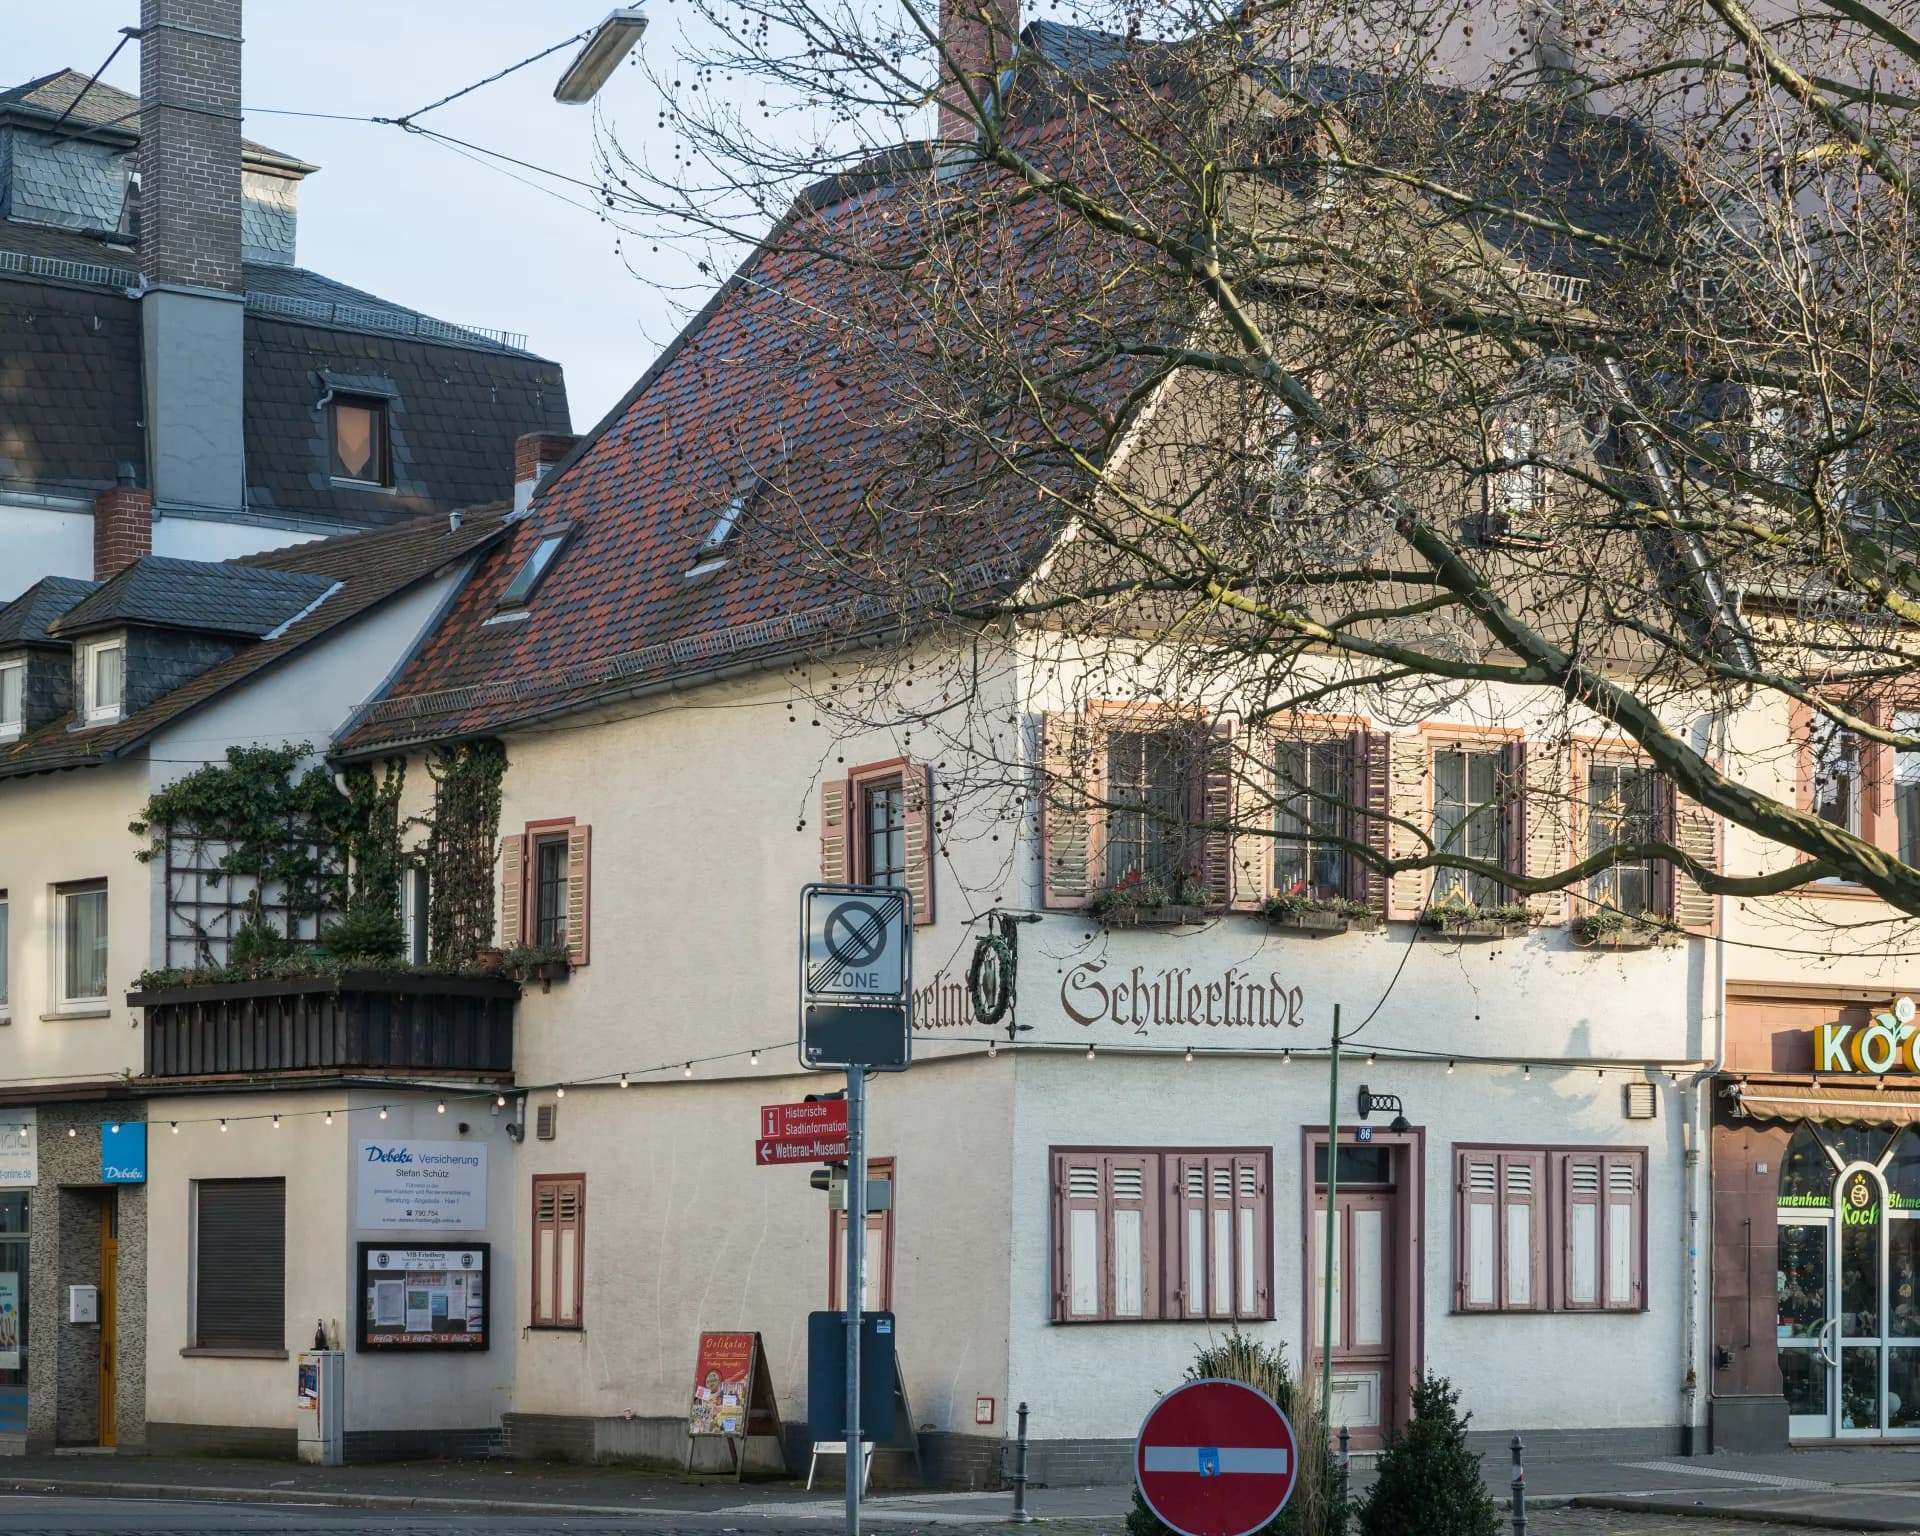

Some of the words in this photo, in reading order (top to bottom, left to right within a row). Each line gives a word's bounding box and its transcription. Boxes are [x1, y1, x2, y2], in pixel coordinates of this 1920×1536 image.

[832, 972, 880, 988] ZONE
[1061, 960, 1304, 1036] Schillerlinde
[785, 1104, 827, 1119] Historische
[786, 1120, 847, 1135] Stadtinformation
[1360, 1128, 1371, 1140] 86
[365, 1146, 413, 1163] Debeka
[419, 1154, 479, 1166] Versicherung
[776, 1141, 846, 1159] Wetterau-Museum
[104, 1166, 143, 1179] Debeka
[396, 1169, 420, 1178] Stefan
[422, 1169, 449, 1178] Schütz
[1777, 1192, 1831, 1206] umenhaus
[1842, 1197, 1879, 1225] Koch
